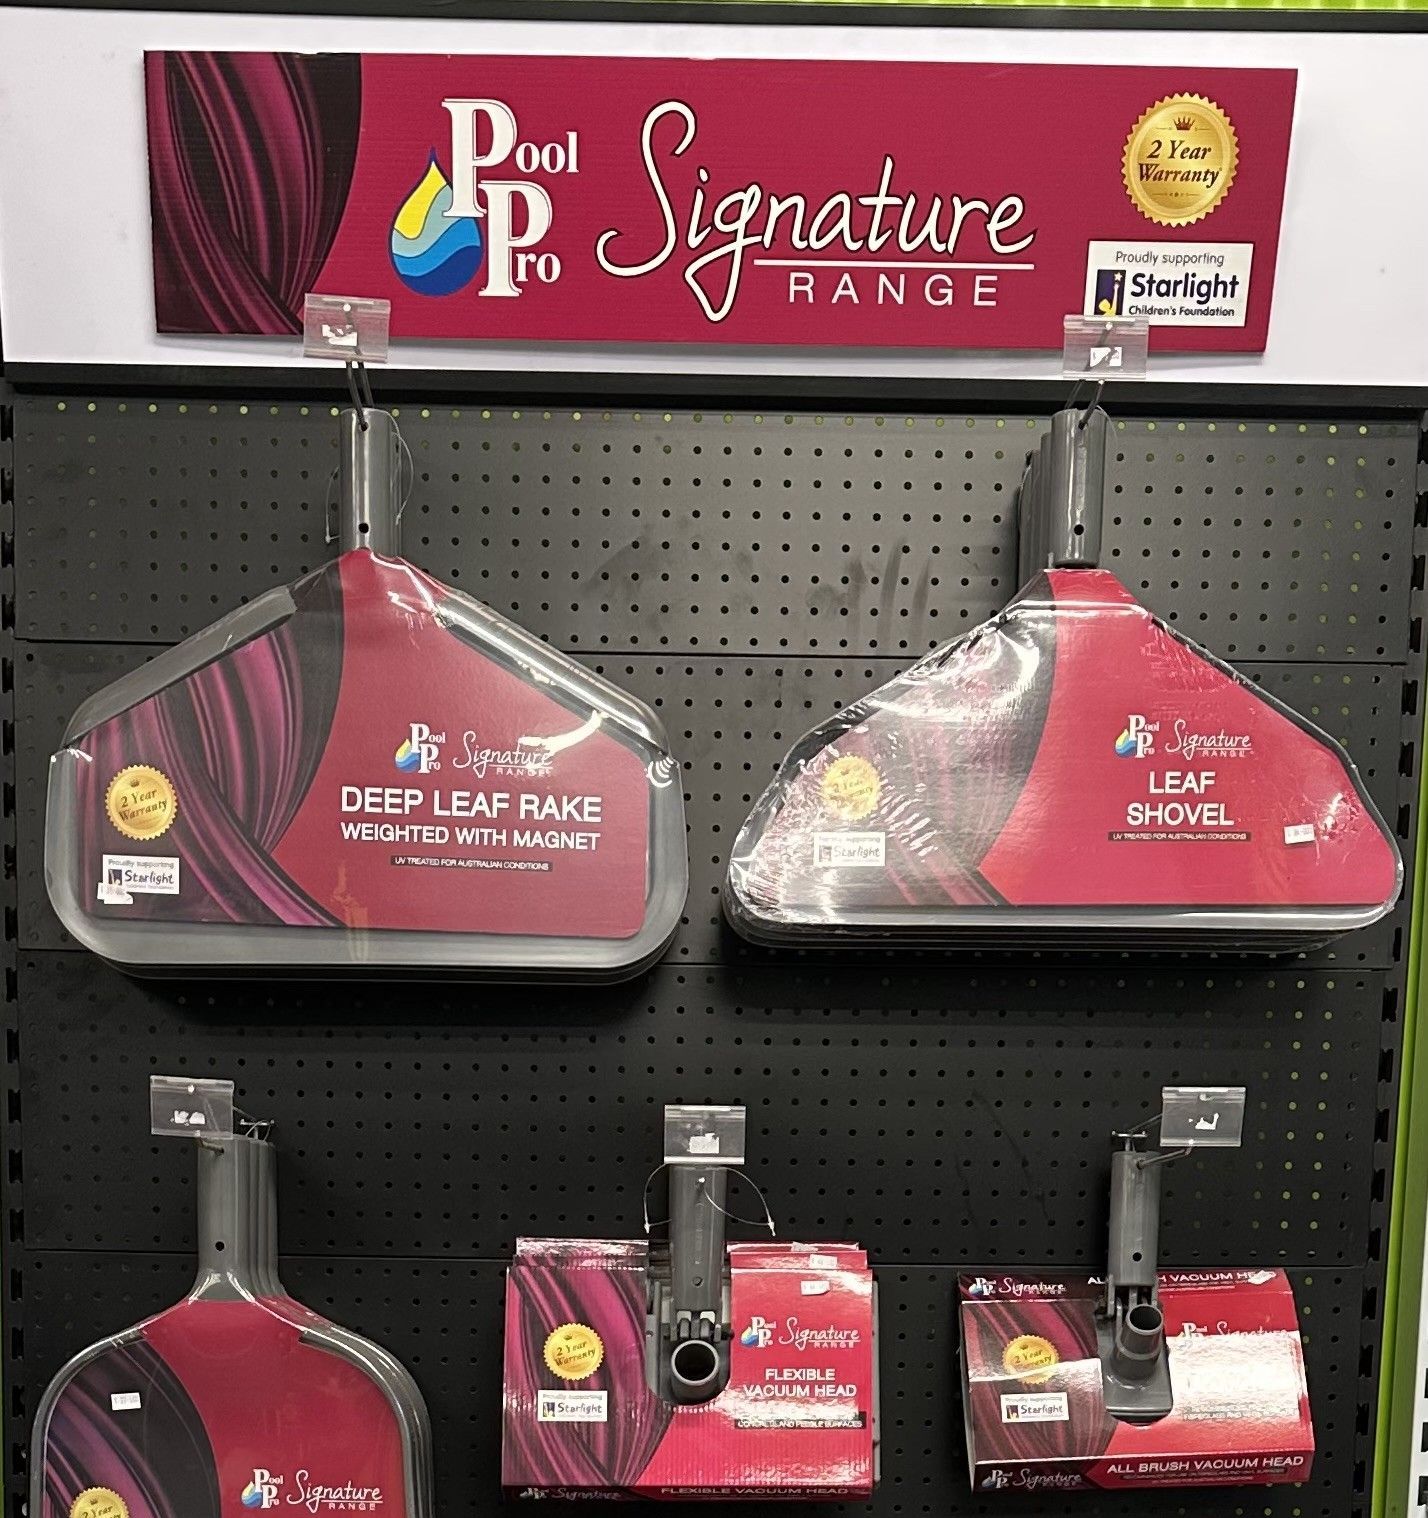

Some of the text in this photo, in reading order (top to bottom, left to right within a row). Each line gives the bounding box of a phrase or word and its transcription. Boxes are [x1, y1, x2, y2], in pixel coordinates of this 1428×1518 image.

[442, 98, 579, 217] Pool
[1146, 139, 1213, 162] 2 Year
[1137, 162, 1220, 188] Warranty
[595, 100, 1038, 322] Signature
[478, 180, 561, 297] Pro
[1115, 250, 1225, 267] Proudly supporting
[788, 271, 1000, 307] RANGE
[1130, 272, 1240, 303] Starlight
[1128, 305, 1235, 317] Children's Foundation
[1165, 719, 1251, 760] Signature
[453, 731, 554, 778] Signature
[1150, 771, 1215, 794] LEAF
[121, 789, 157, 808] 2 Year
[341, 786, 602, 823] DEEP LEAF RAKE
[1126, 803, 1234, 826] SHOVEL
[340, 822, 601, 850] WEIGHTED WITH MAGNET
[124, 869, 174, 885] Starlight
[1170, 1273, 1233, 1281] VACUUM
[779, 1316, 859, 1350] Signature
[765, 1369, 835, 1381] FLEXIBLE
[744, 1384, 857, 1397] VACUUM HEAD
[557, 1403, 602, 1414] Starlight
[1107, 1456, 1303, 1473] ALL BRUSH VACUUM HEAD
[286, 1470, 383, 1513] Signature
